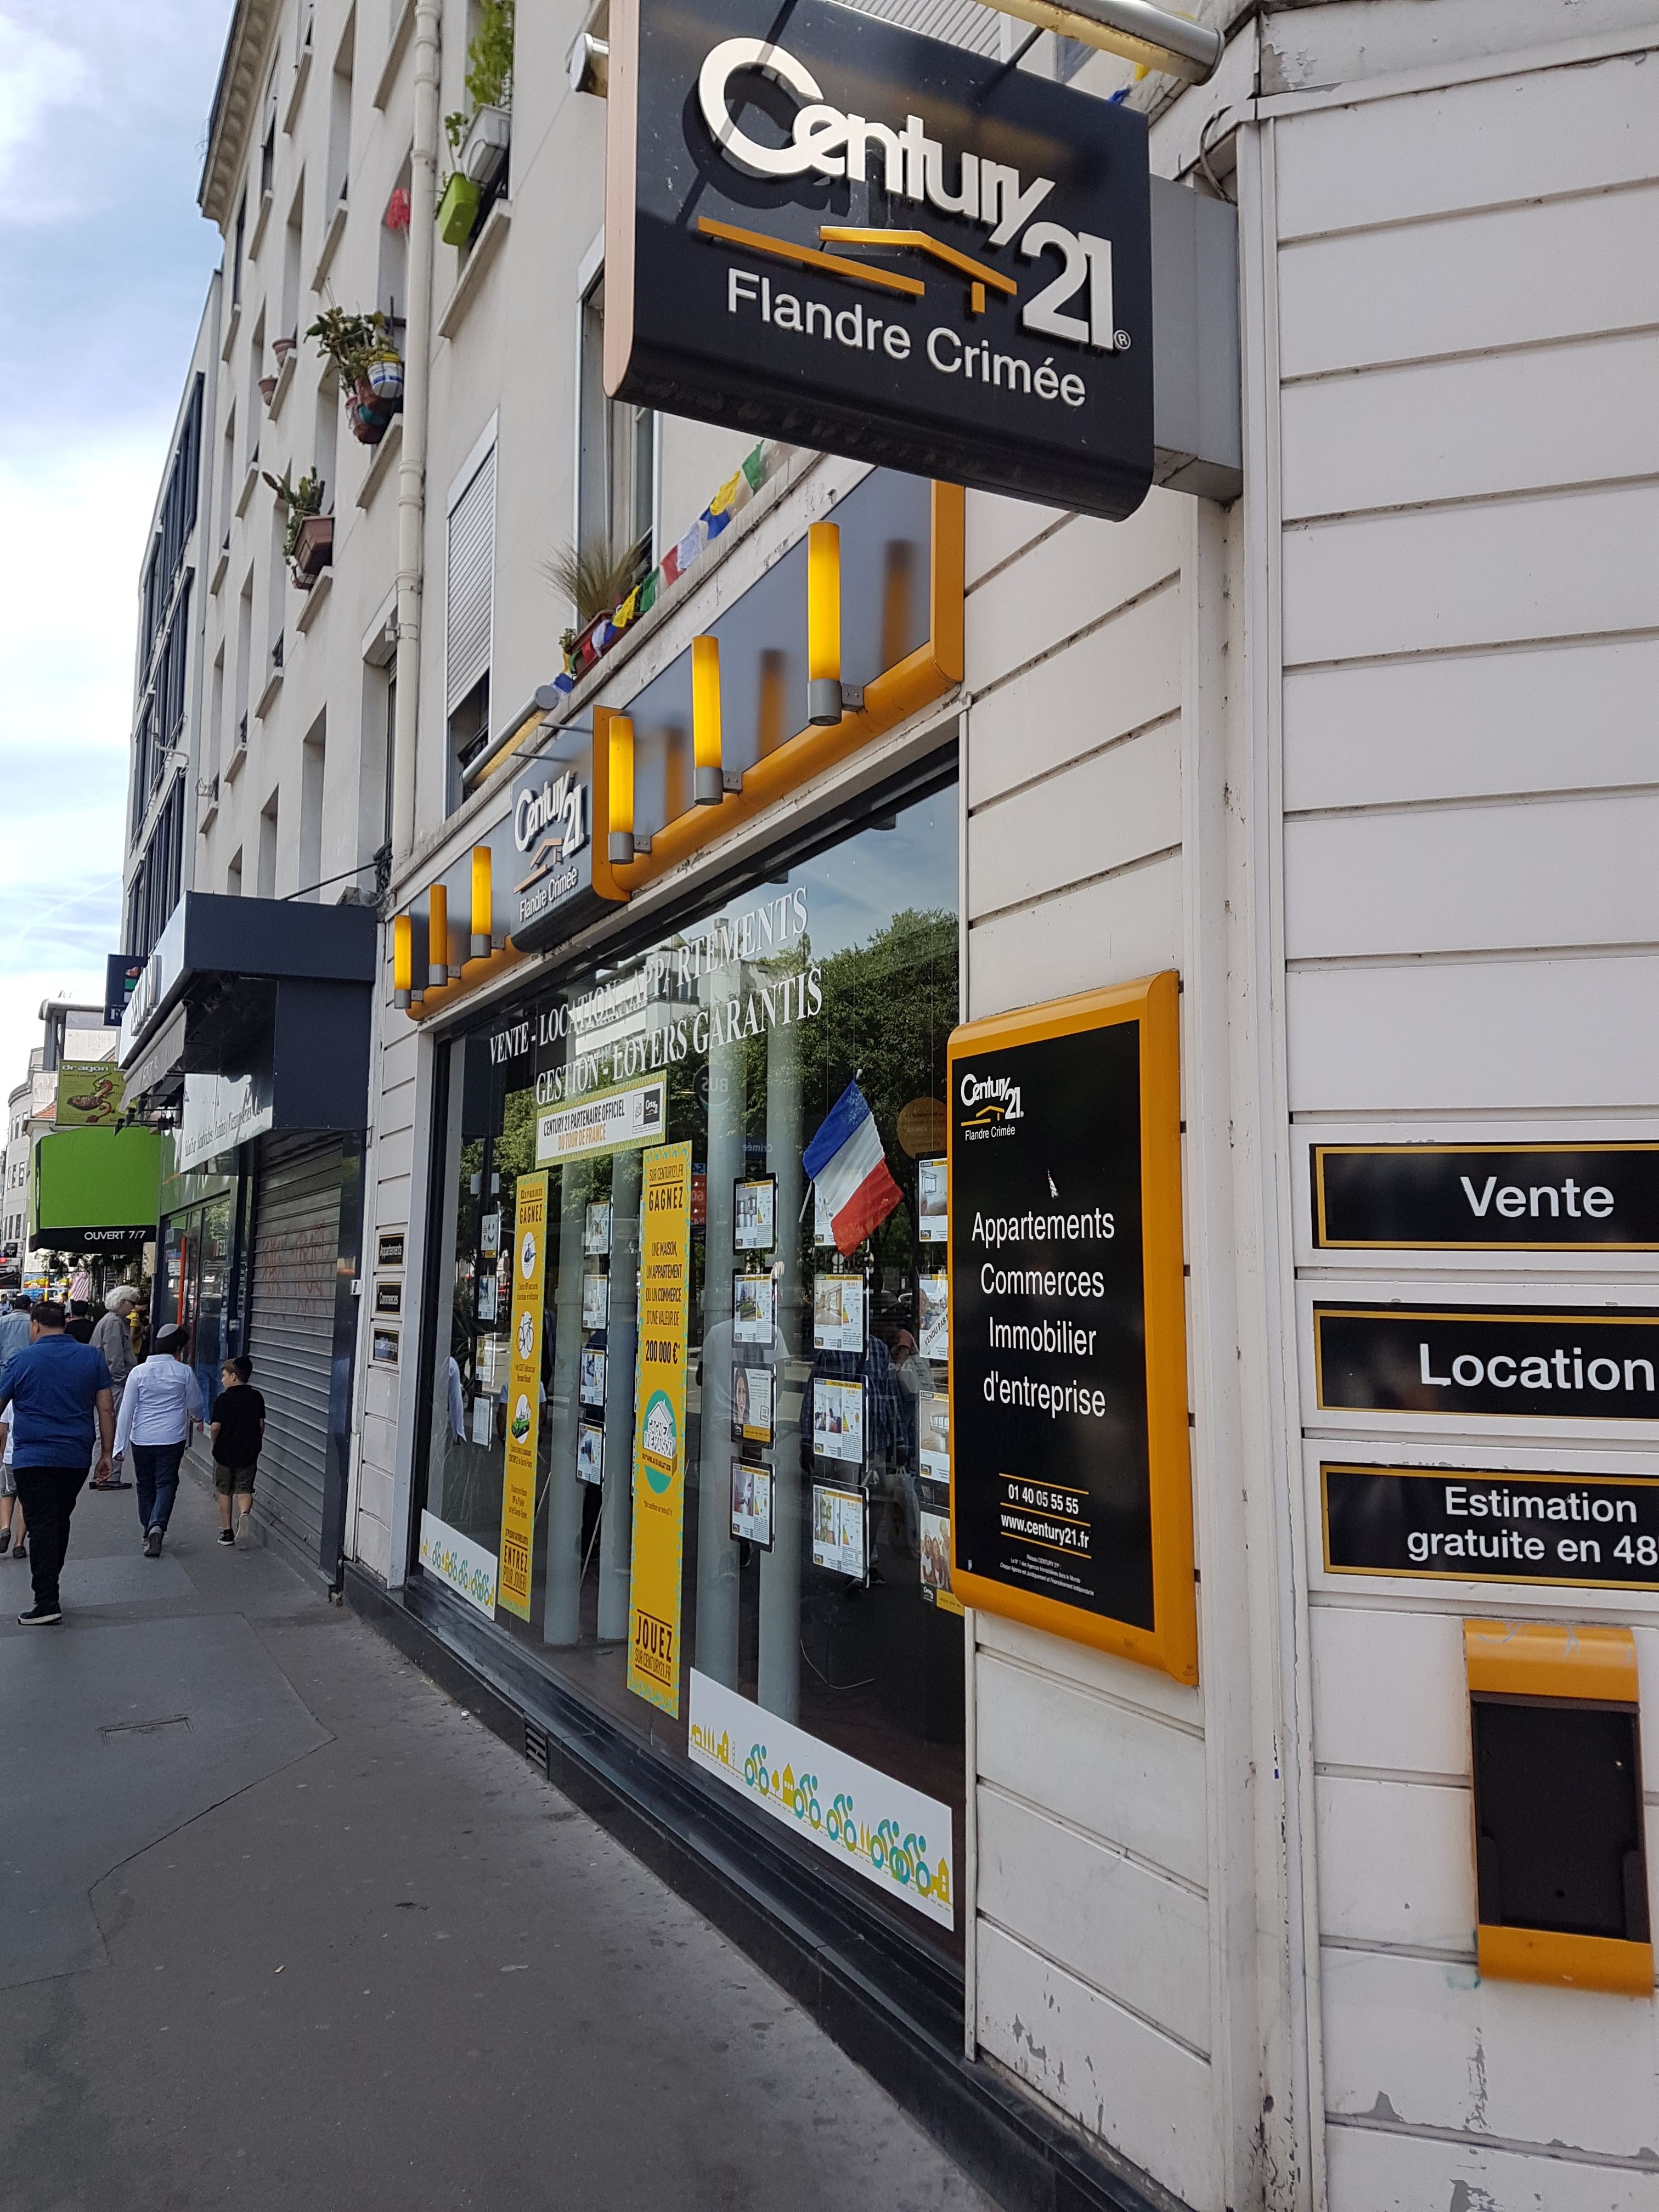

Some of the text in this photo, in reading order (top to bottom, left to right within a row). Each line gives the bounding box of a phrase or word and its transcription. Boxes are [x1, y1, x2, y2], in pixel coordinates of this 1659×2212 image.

[698, 38, 1055, 246] Century
[727, 268, 1086, 407] Flandre Crimée
[514, 770, 570, 852] Century
[520, 866, 577, 922] Flandre Crimée
[489, 1021, 529, 1066] VENTE
[539, 979, 622, 1046] LOCATION
[629, 885, 808, 1008] APPARTEMENTS
[536, 1056, 599, 1105] GESTION
[612, 1020, 687, 1081] LOYERS
[693, 966, 822, 1054] GARANTIS
[61, 1064, 109, 1073] dragon
[961, 1074, 1011, 1107] Century
[544, 1099, 625, 1137] CENTURY 21 PARTENAIRE OFFICIEL
[965, 1124, 1015, 1141] Flandre Crimée
[558, 1124, 606, 1151] DU TOUR DE FRANCE
[657, 1163, 684, 1181] CENTURY21.FR
[649, 1186, 683, 1212] GAGNEZ
[1460, 1176, 1615, 1218] Vente
[520, 1203, 543, 1225] GAGNEZ
[972, 1207, 1115, 1249] Appartements
[84, 1231, 146, 1240] OUVERT 7/7
[651, 1242, 659, 1257] UNE
[646, 1263, 682, 1279] UN APPARTEMENT
[980, 1263, 1105, 1298] Commerces
[646, 1286, 681, 1302] OU UN COMMERCE
[658, 1310, 673, 1327] VALEUR
[673, 1311, 680, 1327] DE
[924, 1317, 947, 1346] VENDU PAR
[646, 1339, 658, 1363] 200
[658, 1340, 672, 1364] 000
[989, 1317, 1097, 1356] Immobilier
[1420, 1343, 1656, 1391] Location
[983, 1371, 1107, 1419] d'entreprise
[1008, 1483, 1079, 1515] 01 40 05 55 55
[1445, 1486, 1637, 1523] Estimation
[1001, 1514, 1090, 1549] www.century21.fr
[1407, 1530, 1545, 1562] gratuite
[1556, 1538, 1601, 1563] en
[503, 1565, 514, 1586] POUR
[504, 1545, 528, 1573] ENTREZ
[635, 1616, 673, 1663] JOUEZ
[635, 1647, 643, 1665] SUR
